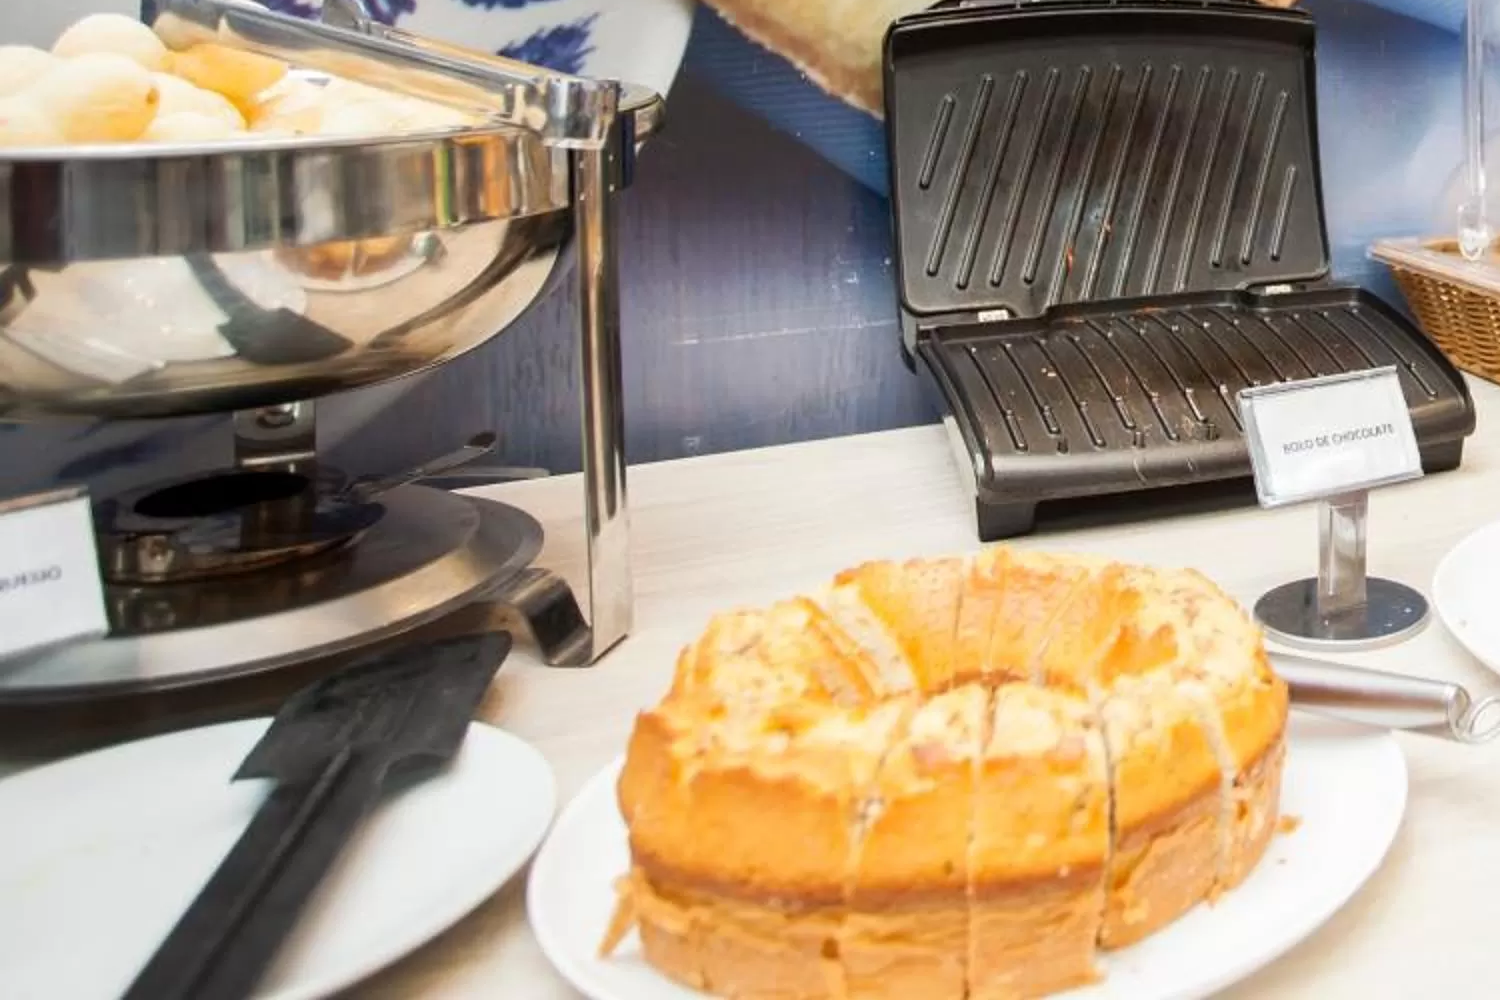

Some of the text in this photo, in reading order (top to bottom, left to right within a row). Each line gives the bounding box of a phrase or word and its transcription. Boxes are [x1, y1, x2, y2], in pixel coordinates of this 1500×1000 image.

[1283, 423, 1395, 454] BOLO DE CHOCOLATE
